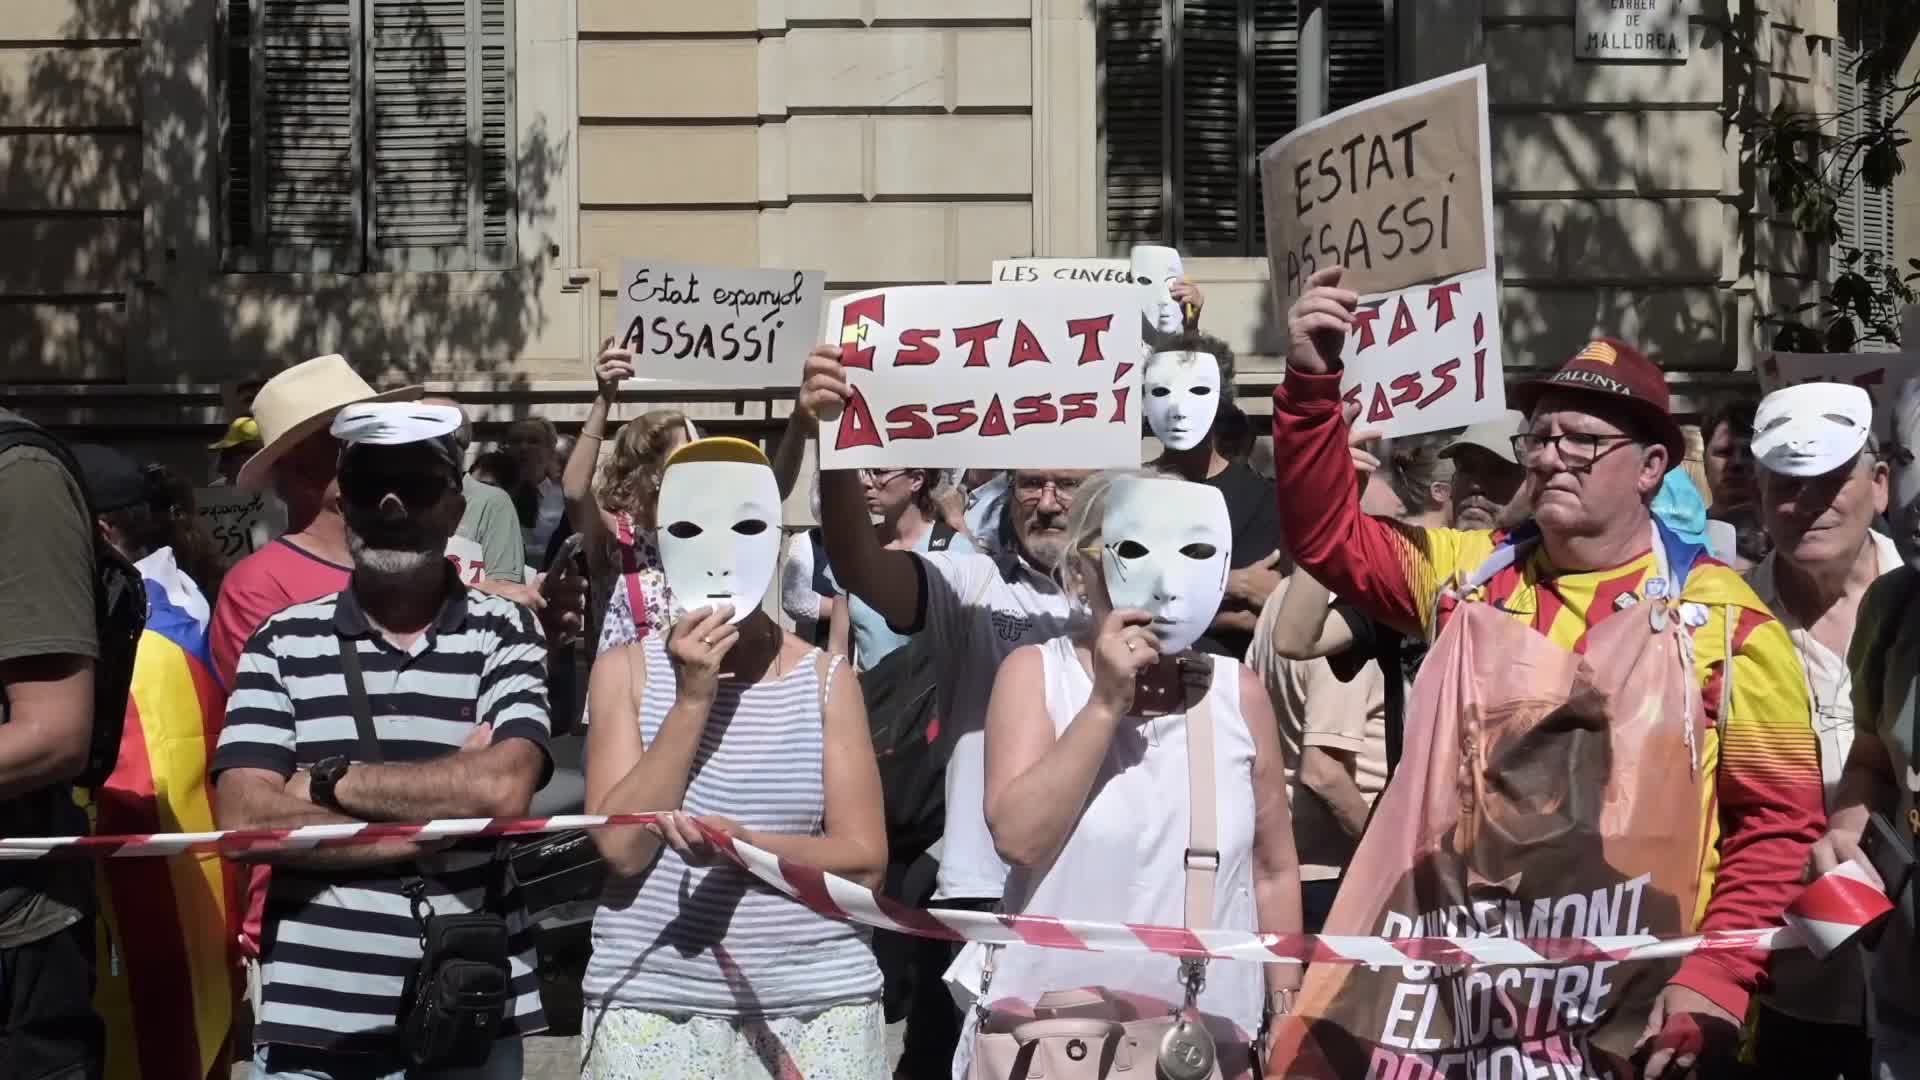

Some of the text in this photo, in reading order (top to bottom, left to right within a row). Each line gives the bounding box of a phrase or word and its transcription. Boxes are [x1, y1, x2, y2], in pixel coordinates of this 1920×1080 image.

[1625, 14, 1641, 26] DE
[1294, 119, 1428, 217] ESTAT
[628, 268, 804, 323] Estat espanyol
[999, 266, 1039, 283] LES
[839, 293, 1115, 372] ESTAT
[1379, 961, 1620, 1050] EL NOSTRE
